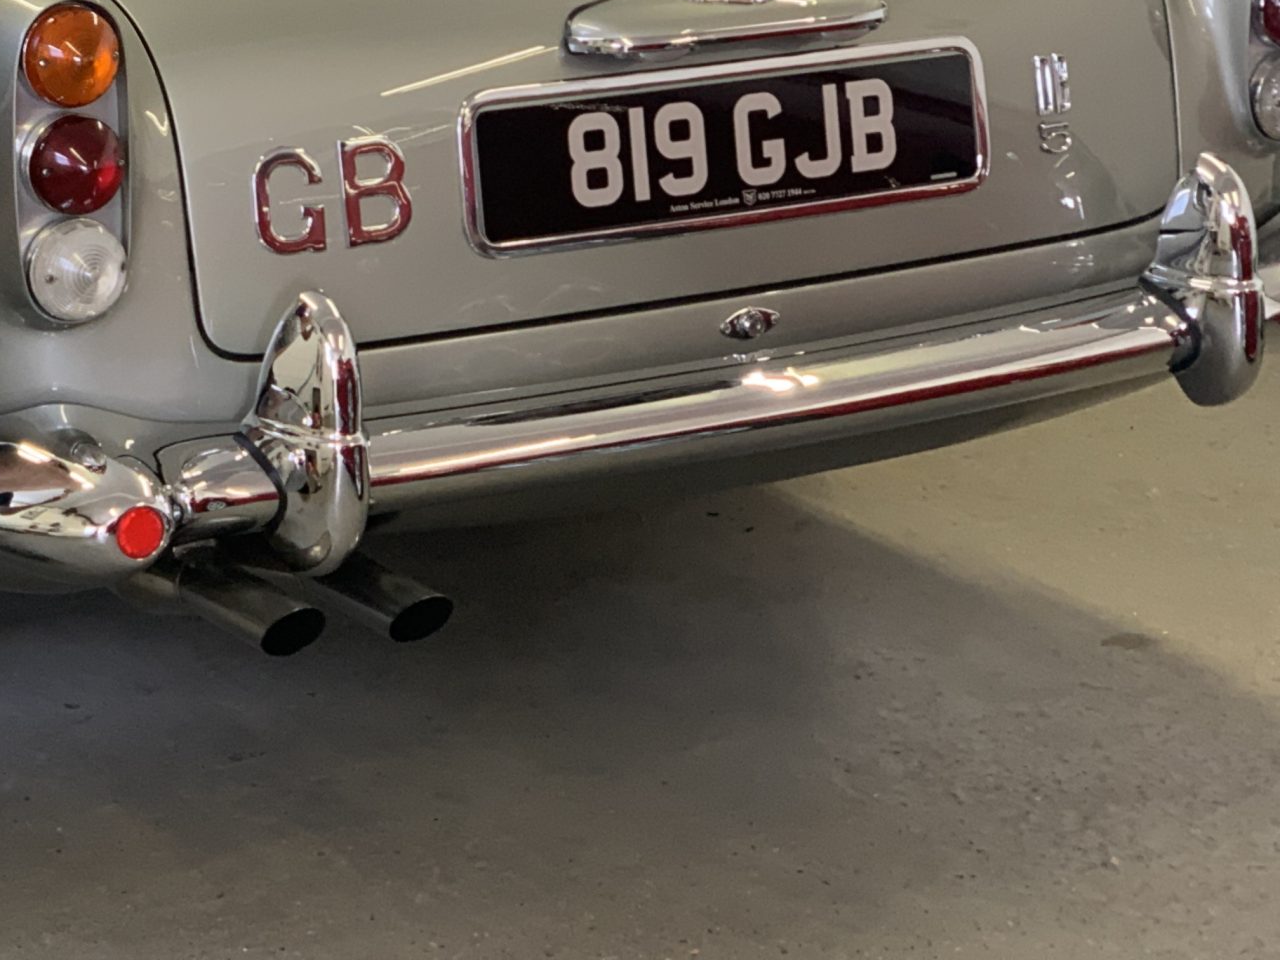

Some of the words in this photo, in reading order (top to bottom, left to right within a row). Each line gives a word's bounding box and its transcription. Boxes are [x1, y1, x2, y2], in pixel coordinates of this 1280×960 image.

[251, 134, 413, 255] GB
[567, 100, 709, 208] 819
[732, 77, 898, 187] GJB
[689, 200, 714, 210] Service
[714, 196, 740, 207] London
